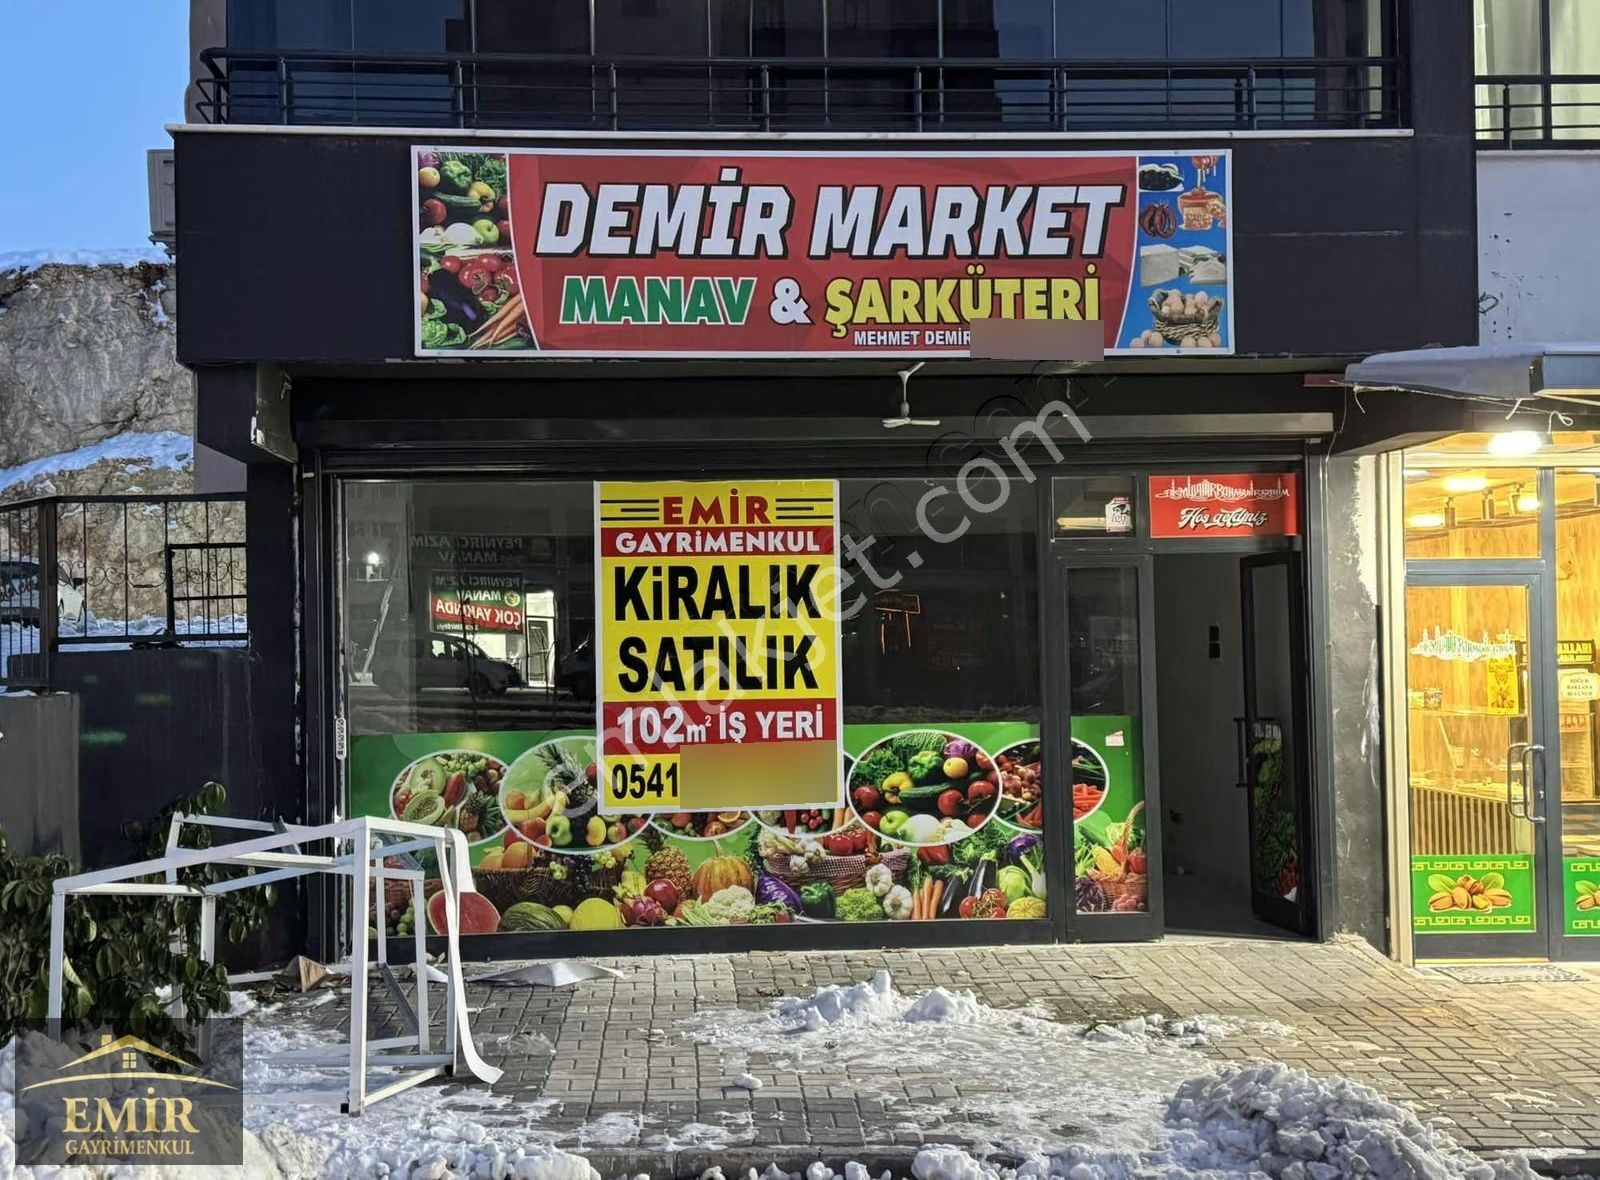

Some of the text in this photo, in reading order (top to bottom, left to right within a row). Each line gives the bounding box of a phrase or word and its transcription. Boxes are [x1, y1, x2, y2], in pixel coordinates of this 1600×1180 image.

[535, 166, 1128, 260] DEMİR MARKET
[559, 263, 1100, 338] MANAV & ŞARKÜTERİ
[854, 331, 920, 346] MEHMET
[663, 488, 771, 525] EMİR
[618, 634, 819, 693] SATILIK
[719, 705, 747, 743] İŞ
[755, 704, 824, 740] YERİ
[611, 762, 679, 799] 0541
